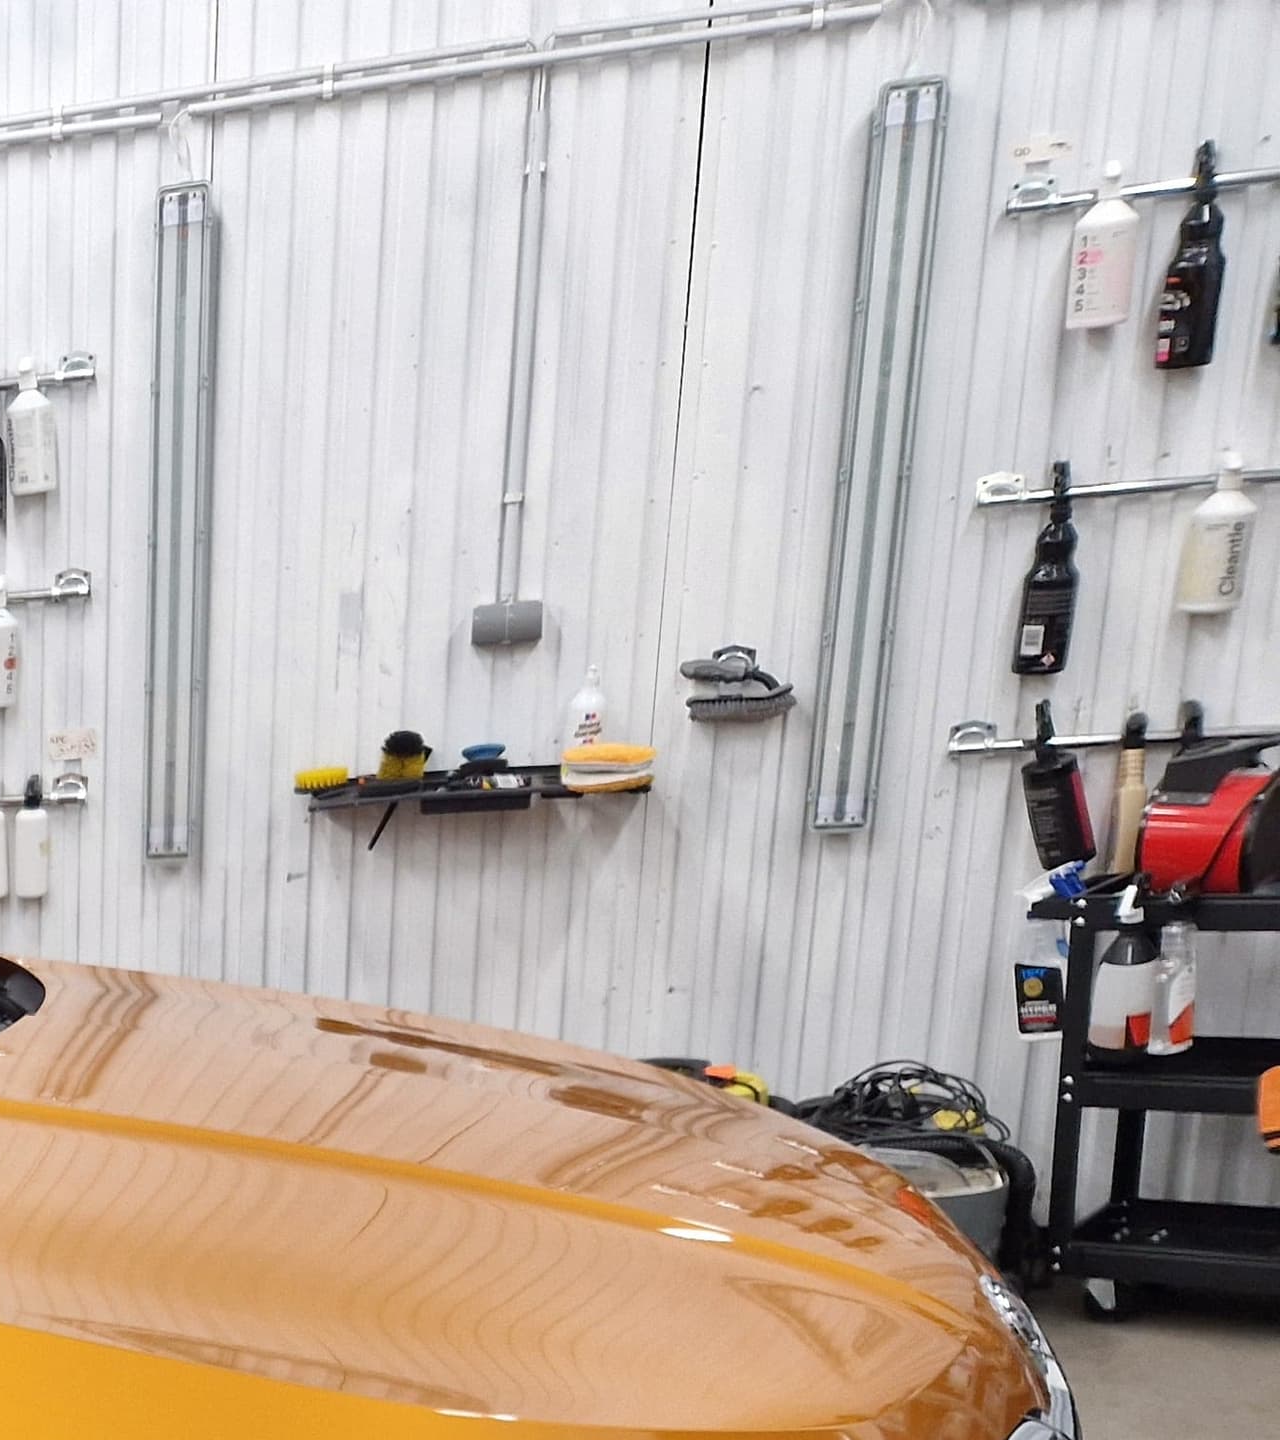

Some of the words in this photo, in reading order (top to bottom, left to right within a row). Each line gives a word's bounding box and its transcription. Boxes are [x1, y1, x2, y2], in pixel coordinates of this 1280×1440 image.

[1081, 235, 1088, 247] 1
[1078, 250, 1088, 265] 2
[1078, 267, 1087, 281] 3
[1075, 283, 1085, 296] 4
[1074, 299, 1084, 312] 5
[1219, 521, 1245, 596] Cleantle
